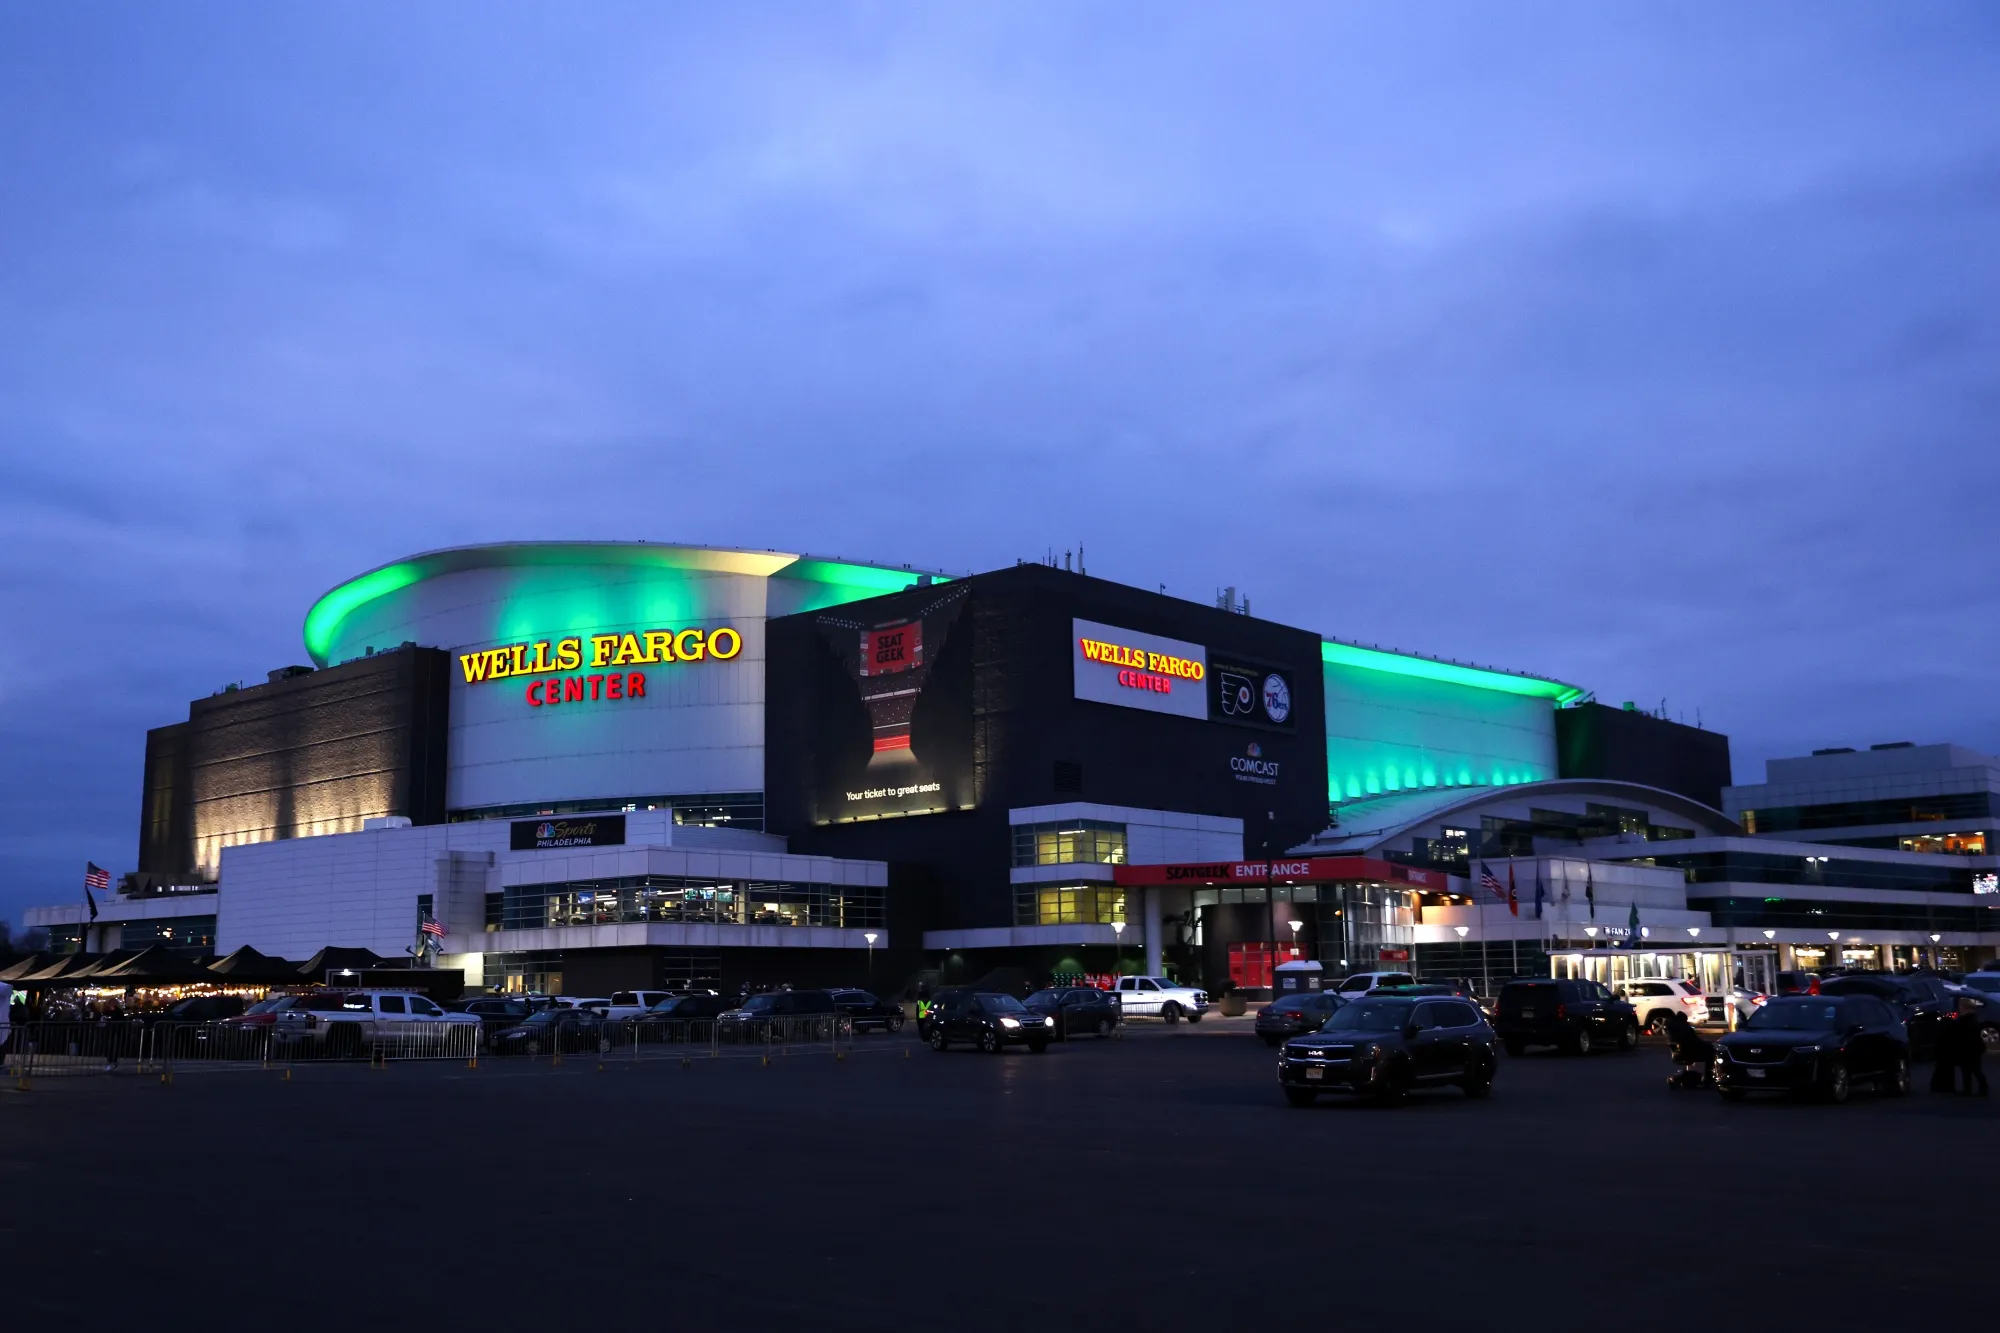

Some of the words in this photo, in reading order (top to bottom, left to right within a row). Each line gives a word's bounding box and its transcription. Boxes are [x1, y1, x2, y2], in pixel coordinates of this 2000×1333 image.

[878, 632, 904, 650] SEAT
[460, 639, 582, 683] WELLS
[590, 627, 742, 668] FARGO
[876, 647, 905, 663] GEEK
[1081, 638, 1145, 669] WELLS
[1147, 652, 1204, 681] FARGO
[526, 673, 646, 706] CENTER
[1118, 670, 1171, 694] CENTER
[1230, 757, 1279, 776] COMCAST
[846, 792, 863, 801] Your
[864, 788, 886, 799] ticket
[887, 787, 896, 796] to
[897, 784, 918, 797] great
[919, 782, 940, 793] seats
[555, 821, 597, 838] Sports
[536, 837, 592, 847] PHILADELPHIA
[1166, 864, 1230, 880] SEATGEEK
